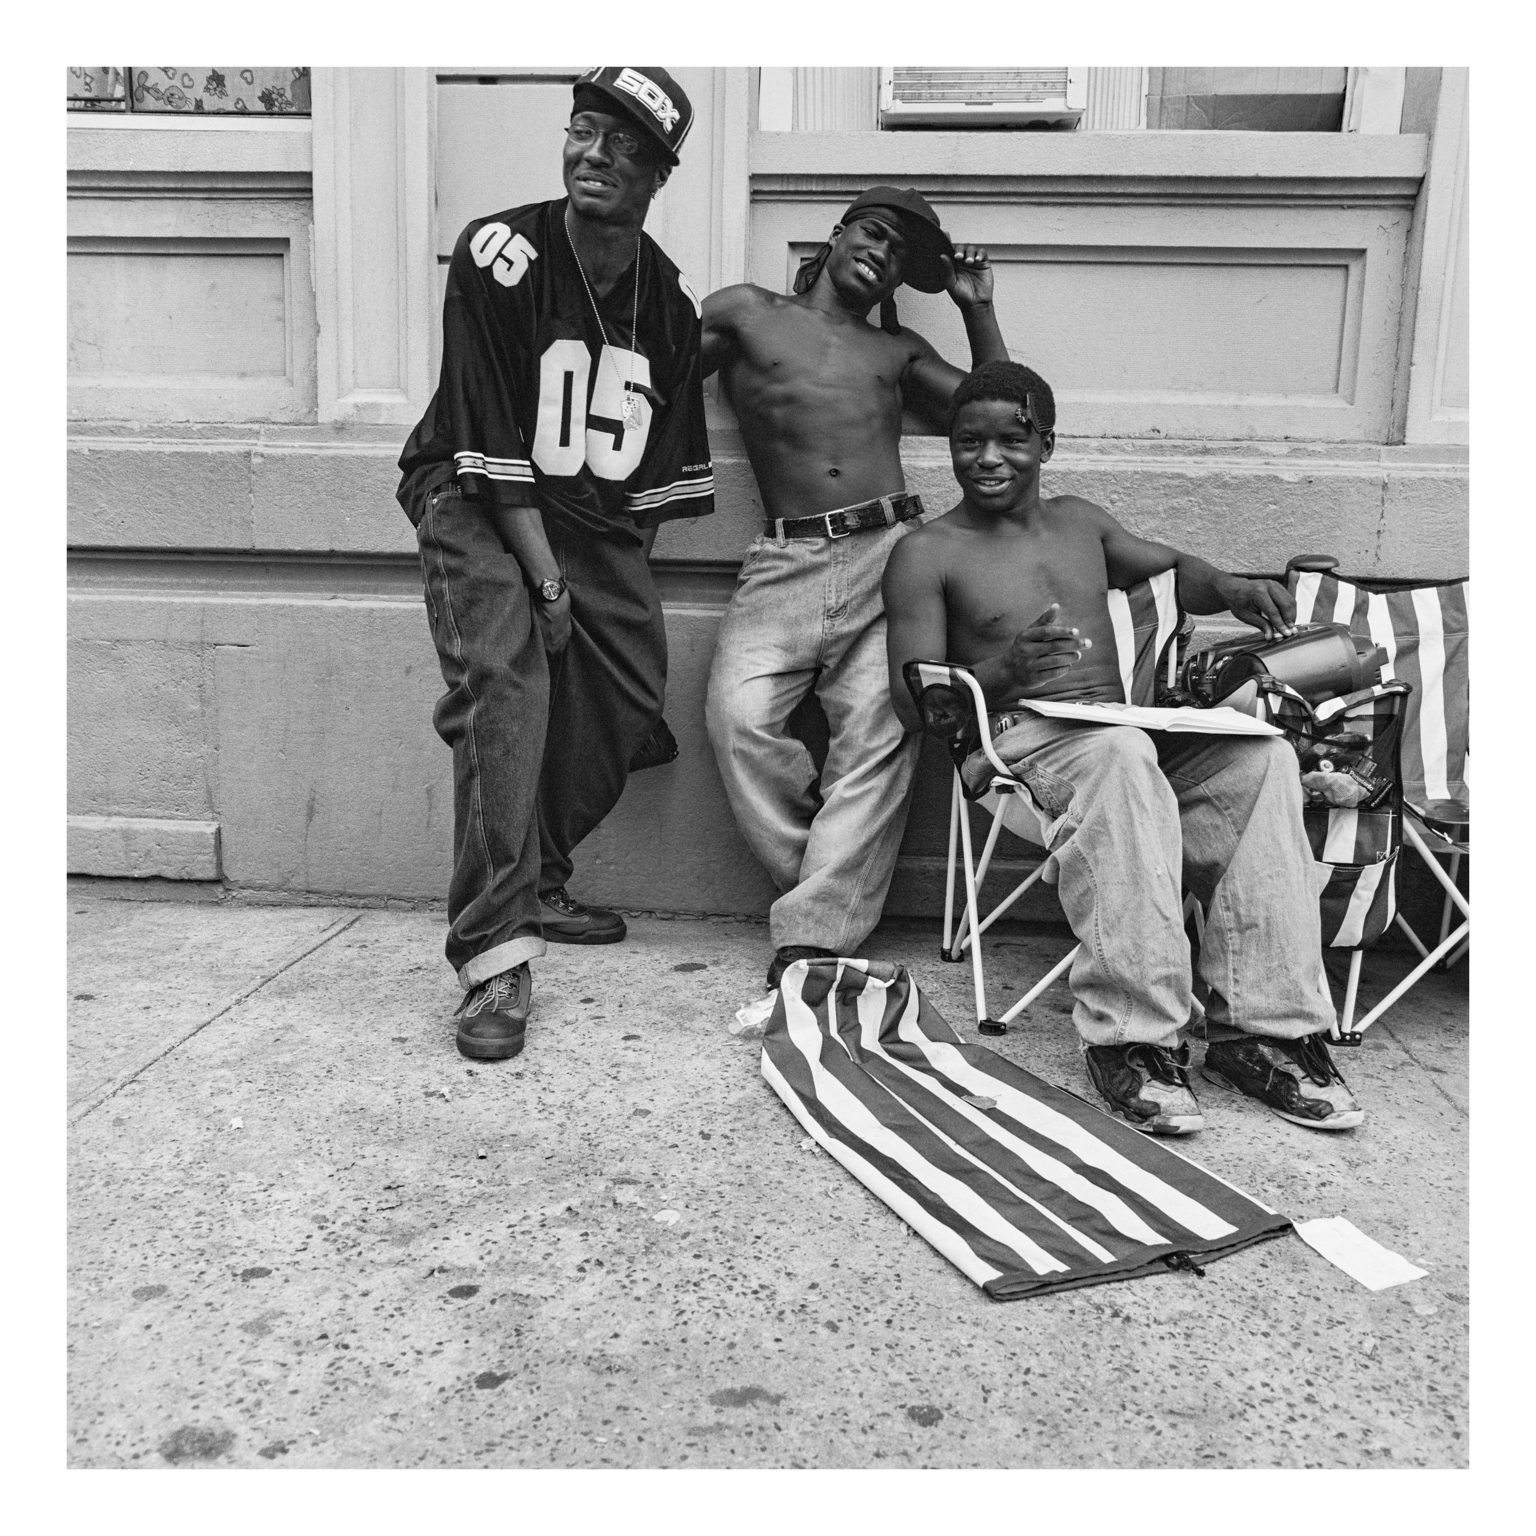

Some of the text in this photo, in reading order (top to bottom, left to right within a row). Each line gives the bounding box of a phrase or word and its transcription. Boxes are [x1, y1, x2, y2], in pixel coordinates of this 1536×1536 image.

[613, 67, 680, 134] SOX
[469, 222, 539, 288] 05
[531, 339, 653, 481] 05
